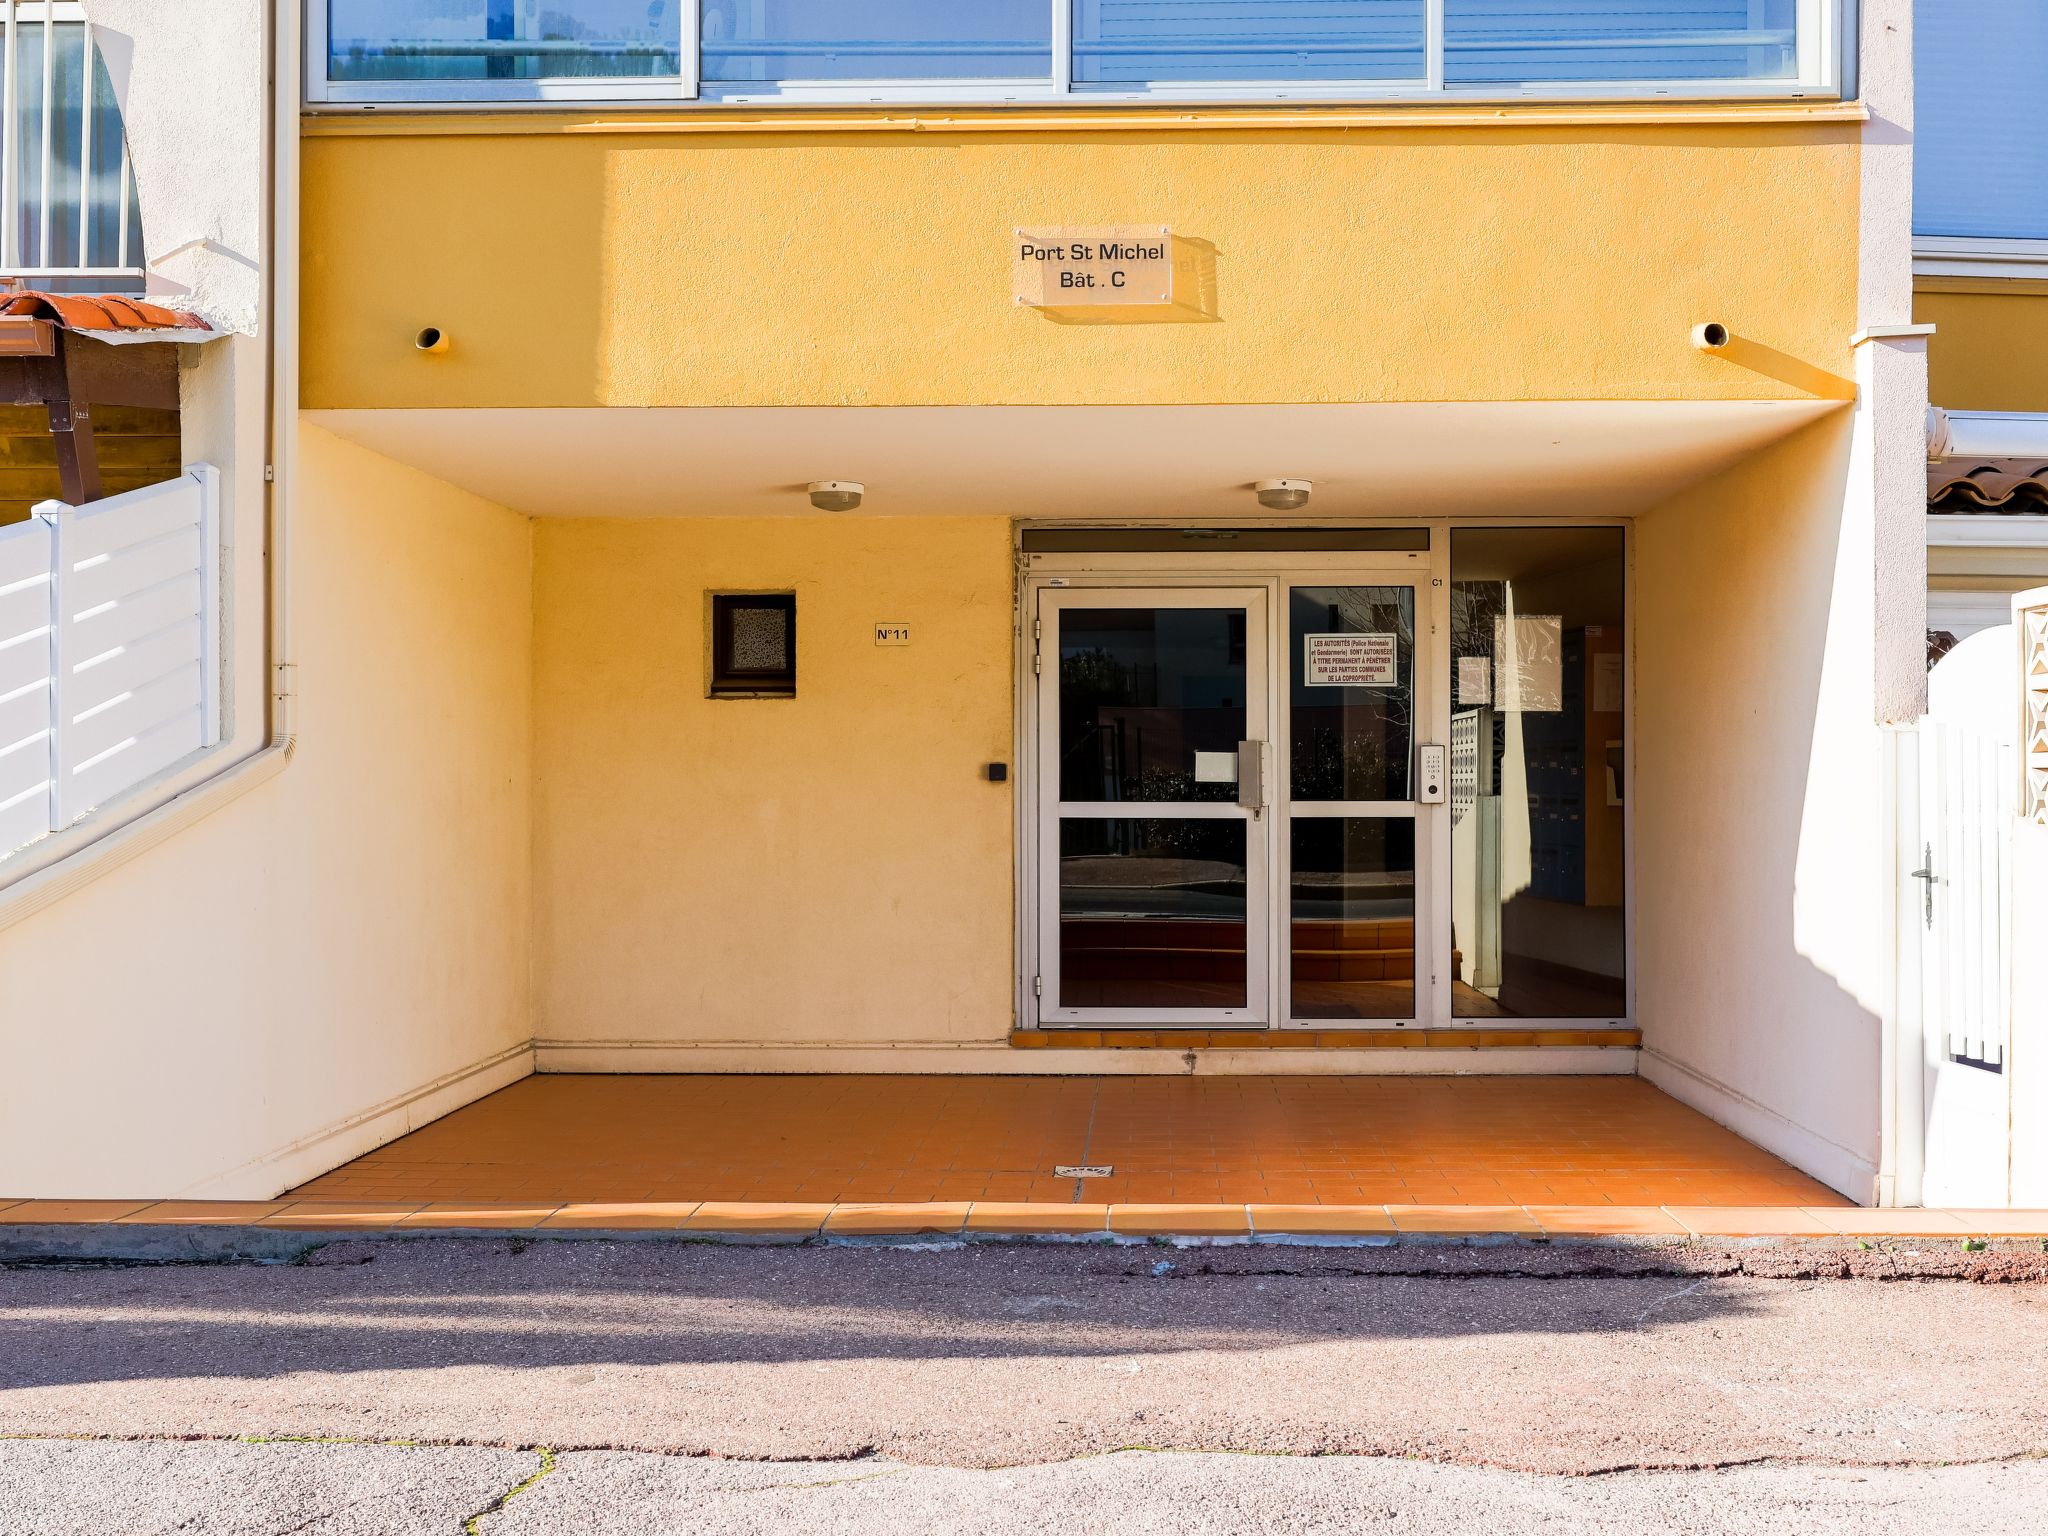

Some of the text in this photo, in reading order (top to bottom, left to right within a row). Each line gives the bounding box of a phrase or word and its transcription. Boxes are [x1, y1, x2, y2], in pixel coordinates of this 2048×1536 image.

[1021, 243, 1164, 260] Port St Michel
[1060, 271, 1095, 288] Bât
[1111, 271, 1125, 287] C
[1432, 578, 1442, 586] C1
[877, 629, 908, 640] N°11
